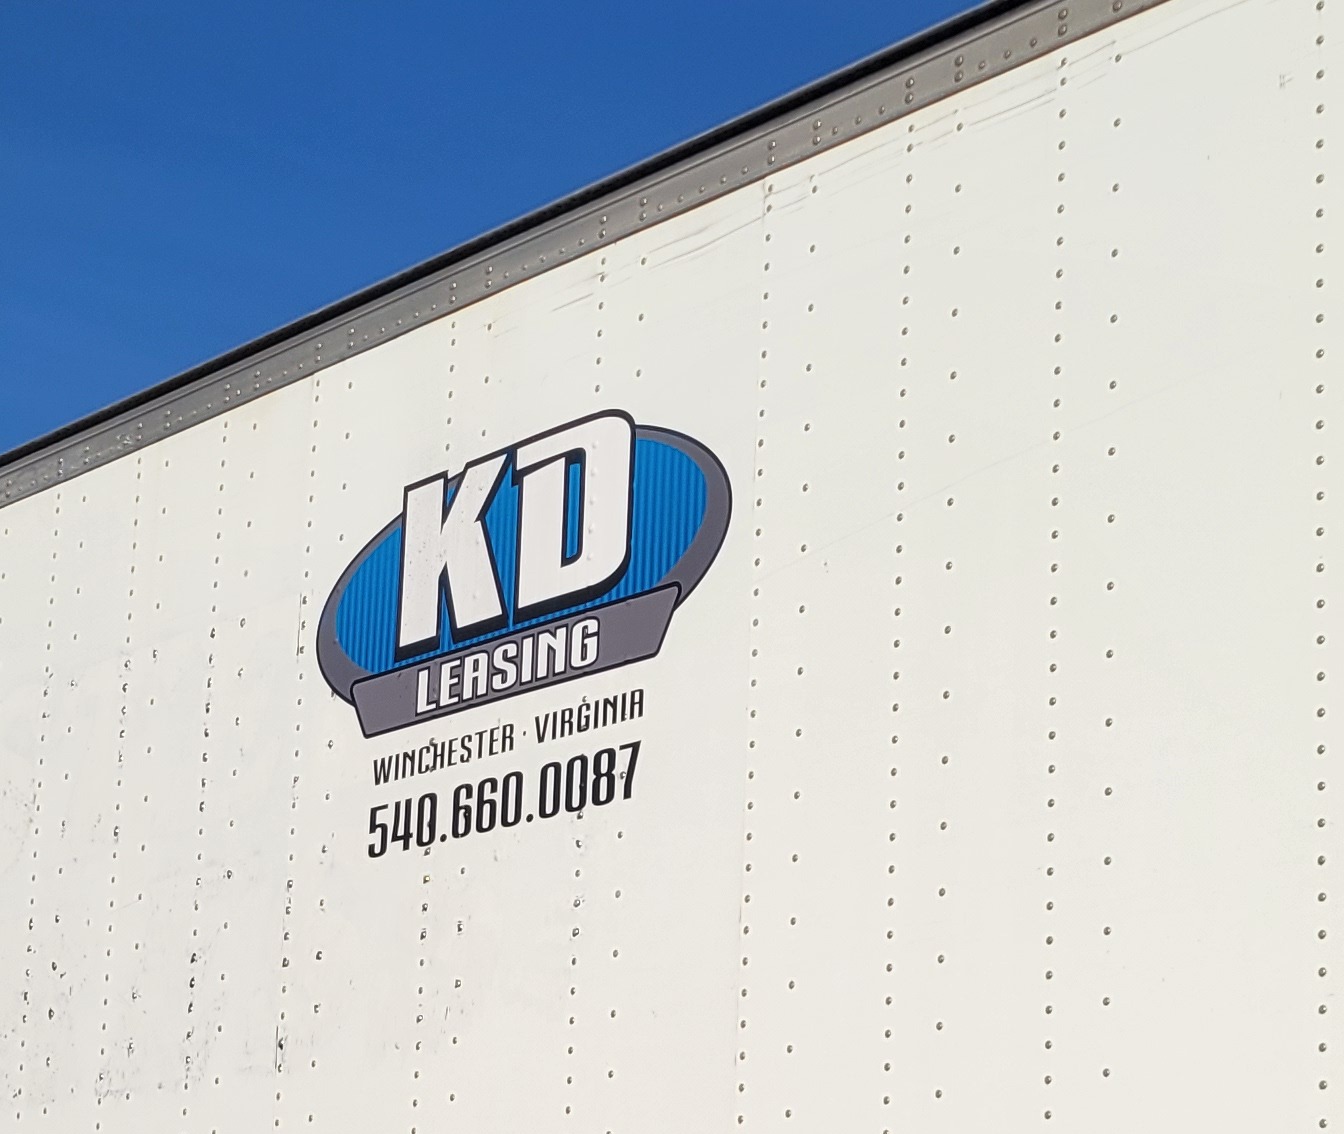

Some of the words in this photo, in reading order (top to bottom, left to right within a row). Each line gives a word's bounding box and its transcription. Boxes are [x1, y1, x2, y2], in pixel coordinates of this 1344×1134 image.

[395, 409, 635, 662] KD
[415, 616, 600, 714] LEASING
[373, 722, 514, 786] WINCHESTER
[534, 688, 644, 743] VIRGINIA
[367, 740, 642, 858] 540.660.0087
